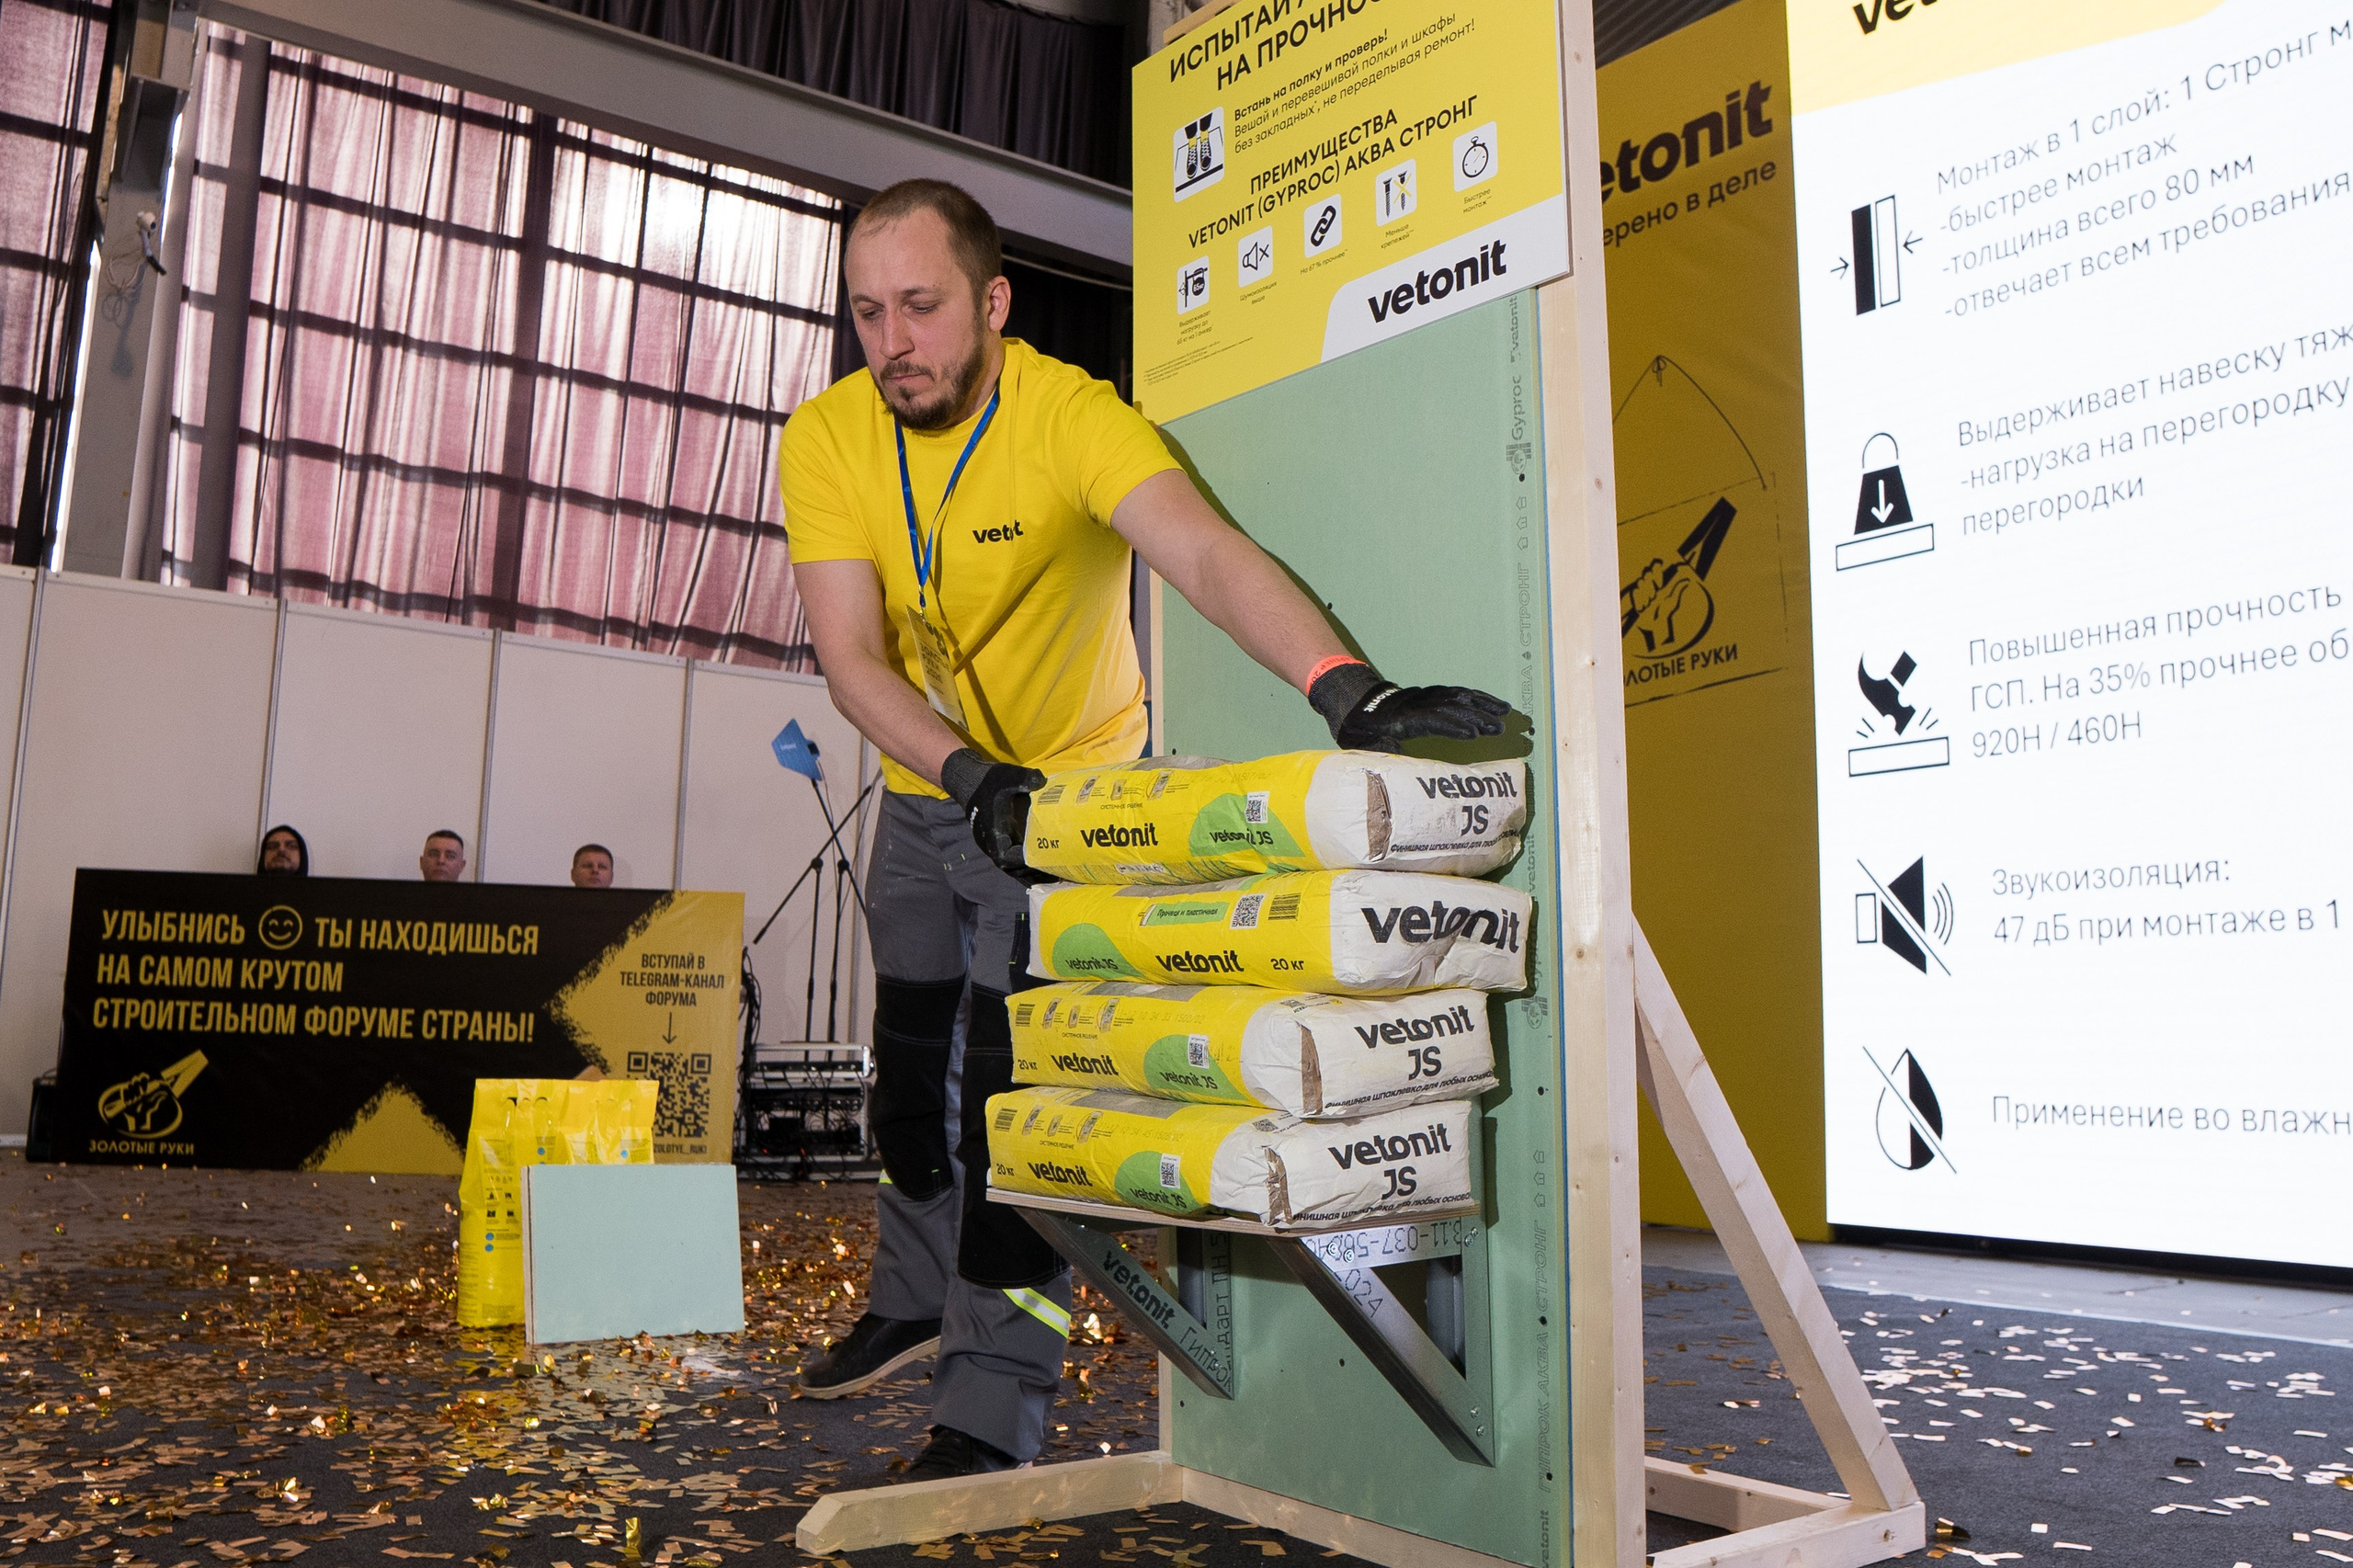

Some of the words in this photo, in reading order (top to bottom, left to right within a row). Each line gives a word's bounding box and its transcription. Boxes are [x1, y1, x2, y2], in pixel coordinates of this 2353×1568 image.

[1853, 0, 1937, 35] ve
[1218, 54, 1252, 91] НА
[1257, 0, 1382, 68] ПРОЧНО
[1234, 96, 1271, 121] Встань
[1273, 86, 1287, 100] на
[1289, 66, 1323, 95] полку
[1324, 59, 1332, 73] и
[1335, 28, 1389, 68] проверь!
[1234, 113, 1269, 138] Вешай
[1272, 107, 1279, 119] и
[1281, 62, 1358, 114] перевешивай
[1362, 44, 1398, 72] полки
[1401, 38, 1408, 50] и
[1412, 13, 1456, 44] шкафы
[1234, 136, 1253, 153] без
[1323, 92, 1337, 108] не
[1340, 51, 1421, 101] переделывая
[1424, 17, 1475, 59] ремонт!
[1938, 140, 2039, 194] Монтаж
[2047, 133, 2061, 152] в
[2069, 119, 2080, 142] 1
[2091, 89, 2170, 135] слой:
[2180, 76, 2191, 100] 1
[2206, 31, 2319, 91] Стронг
[1188, 201, 1256, 248] VETONIT
[1257, 160, 1340, 218] (GYPROC)
[1345, 135, 1396, 176] АКВА
[1399, 95, 1478, 148] СТРОНГ
[1250, 108, 1398, 194] ПРЕИМУЩЕСТВА
[1687, 192, 1699, 212] в
[1708, 161, 1777, 208] деле
[1940, 176, 2059, 233] -быстрее
[2066, 133, 2177, 190] монтаж
[1943, 221, 2069, 275] -толщина
[2078, 189, 2157, 233] всего
[2166, 168, 2200, 201] 80
[2211, 154, 2255, 187] мм
[1946, 262, 2074, 318] -отвечает
[2082, 239, 2151, 276] всем
[2158, 171, 2352, 255] требования
[1368, 239, 1506, 324] vetonit
[1512, 375, 1526, 440] Gyproc
[1959, 378, 2151, 448] Выдерживает
[2159, 342, 2287, 395] навеску
[2294, 324, 2353, 359] тяж
[1961, 443, 2091, 490] -нагрузка
[2100, 428, 2134, 458] на
[2143, 376, 2351, 449] перегородку
[1962, 477, 2145, 536] перегородки
[1518, 562, 1532, 647] СТРОНГ
[1970, 617, 2157, 666] Повышенная
[2167, 586, 2342, 636] прочность
[1623, 656, 1686, 687] ЛОТЫЕ
[1691, 643, 1738, 671] РУКИ
[1971, 679, 2034, 712] ГСП.
[2043, 673, 2080, 701] На
[2089, 662, 2151, 695] 35%
[2160, 644, 2298, 689] прочнее
[1972, 724, 2040, 758] 920Н
[2050, 722, 2060, 749] /
[2067, 711, 2142, 744] 460Н
[1416, 771, 1518, 800] vetonit
[1081, 823, 1158, 847] vetonit
[1256, 831, 1274, 845] JS
[1461, 804, 1489, 835] JS
[1037, 836, 1049, 849] 20
[1049, 838, 1060, 849] кг
[1391, 842, 1428, 853] Финишная
[1429, 840, 1469, 851] шпаклевка
[1993, 858, 2231, 900] Звукоизоляция:
[100, 910, 245, 945] УЛЫБНИСЬ
[315, 917, 353, 948] ТЫ
[359, 920, 540, 956] НАХОДИШЬСЯ
[1156, 907, 1180, 919] Прочная
[1361, 900, 1519, 953] vetonit
[1994, 915, 2024, 944] 47
[2033, 914, 2070, 947] дБ
[2079, 915, 2133, 945] при
[2143, 908, 2286, 937] монтаже
[2298, 907, 2314, 931] в
[2325, 899, 2340, 928] 1
[97, 953, 131, 984] НА
[138, 955, 233, 989] САМОМ
[240, 958, 344, 993] КРУТОМ
[620, 971, 725, 989] TELEGRAM-КАНАЛ
[642, 952, 695, 970] ВСТУПАЙ
[698, 954, 706, 970] В
[1066, 955, 1102, 971] vetonit
[1102, 957, 1119, 970] JS
[1155, 949, 1244, 973] vetonit
[1270, 959, 1289, 970] 20
[1290, 960, 1304, 971] кг
[93, 997, 297, 1035] СТРОИТЕЛЬНОМ
[304, 1006, 415, 1040] ФОРУМЕ
[422, 1009, 535, 1043] СТРАНЫ!
[645, 991, 697, 1006] ФОРУМА
[1354, 1005, 1475, 1049] vetonit
[1017, 1059, 1029, 1070] 20
[1029, 1060, 1038, 1071] кг
[1051, 1052, 1119, 1076] vetonit
[1160, 1071, 1201, 1088] vetonit
[1201, 1075, 1218, 1090] JS
[1408, 1046, 1442, 1081] JS
[1371, 1085, 1423, 1101] шпаклевка
[1422, 1083, 1438, 1092] для
[1438, 1077, 1467, 1088] любых
[1993, 1096, 2183, 1129] Применение
[2195, 1108, 2229, 1131] во
[2242, 1108, 2351, 1136] влажн
[89, 1140, 155, 1155] ЗОЛОТЫЕ
[159, 1140, 195, 1156] РУКИ
[1327, 1122, 1452, 1170] vetonit
[996, 1163, 1006, 1176] 20
[1006, 1166, 1015, 1176] кг
[1028, 1161, 1093, 1187] vetonit
[1381, 1165, 1417, 1199] JS
[1130, 1187, 1170, 1205] vetonit
[1170, 1194, 1188, 1209] JS
[1292, 1210, 1339, 1221] инишная
[1411, 1197, 1441, 1206] любых
[1211, 1256, 1229, 1285] ПН
[1534, 1220, 1548, 1312] СТРОНГ
[1102, 1249, 1176, 1330] vetonit
[1536, 1332, 1550, 1396] АКВА
